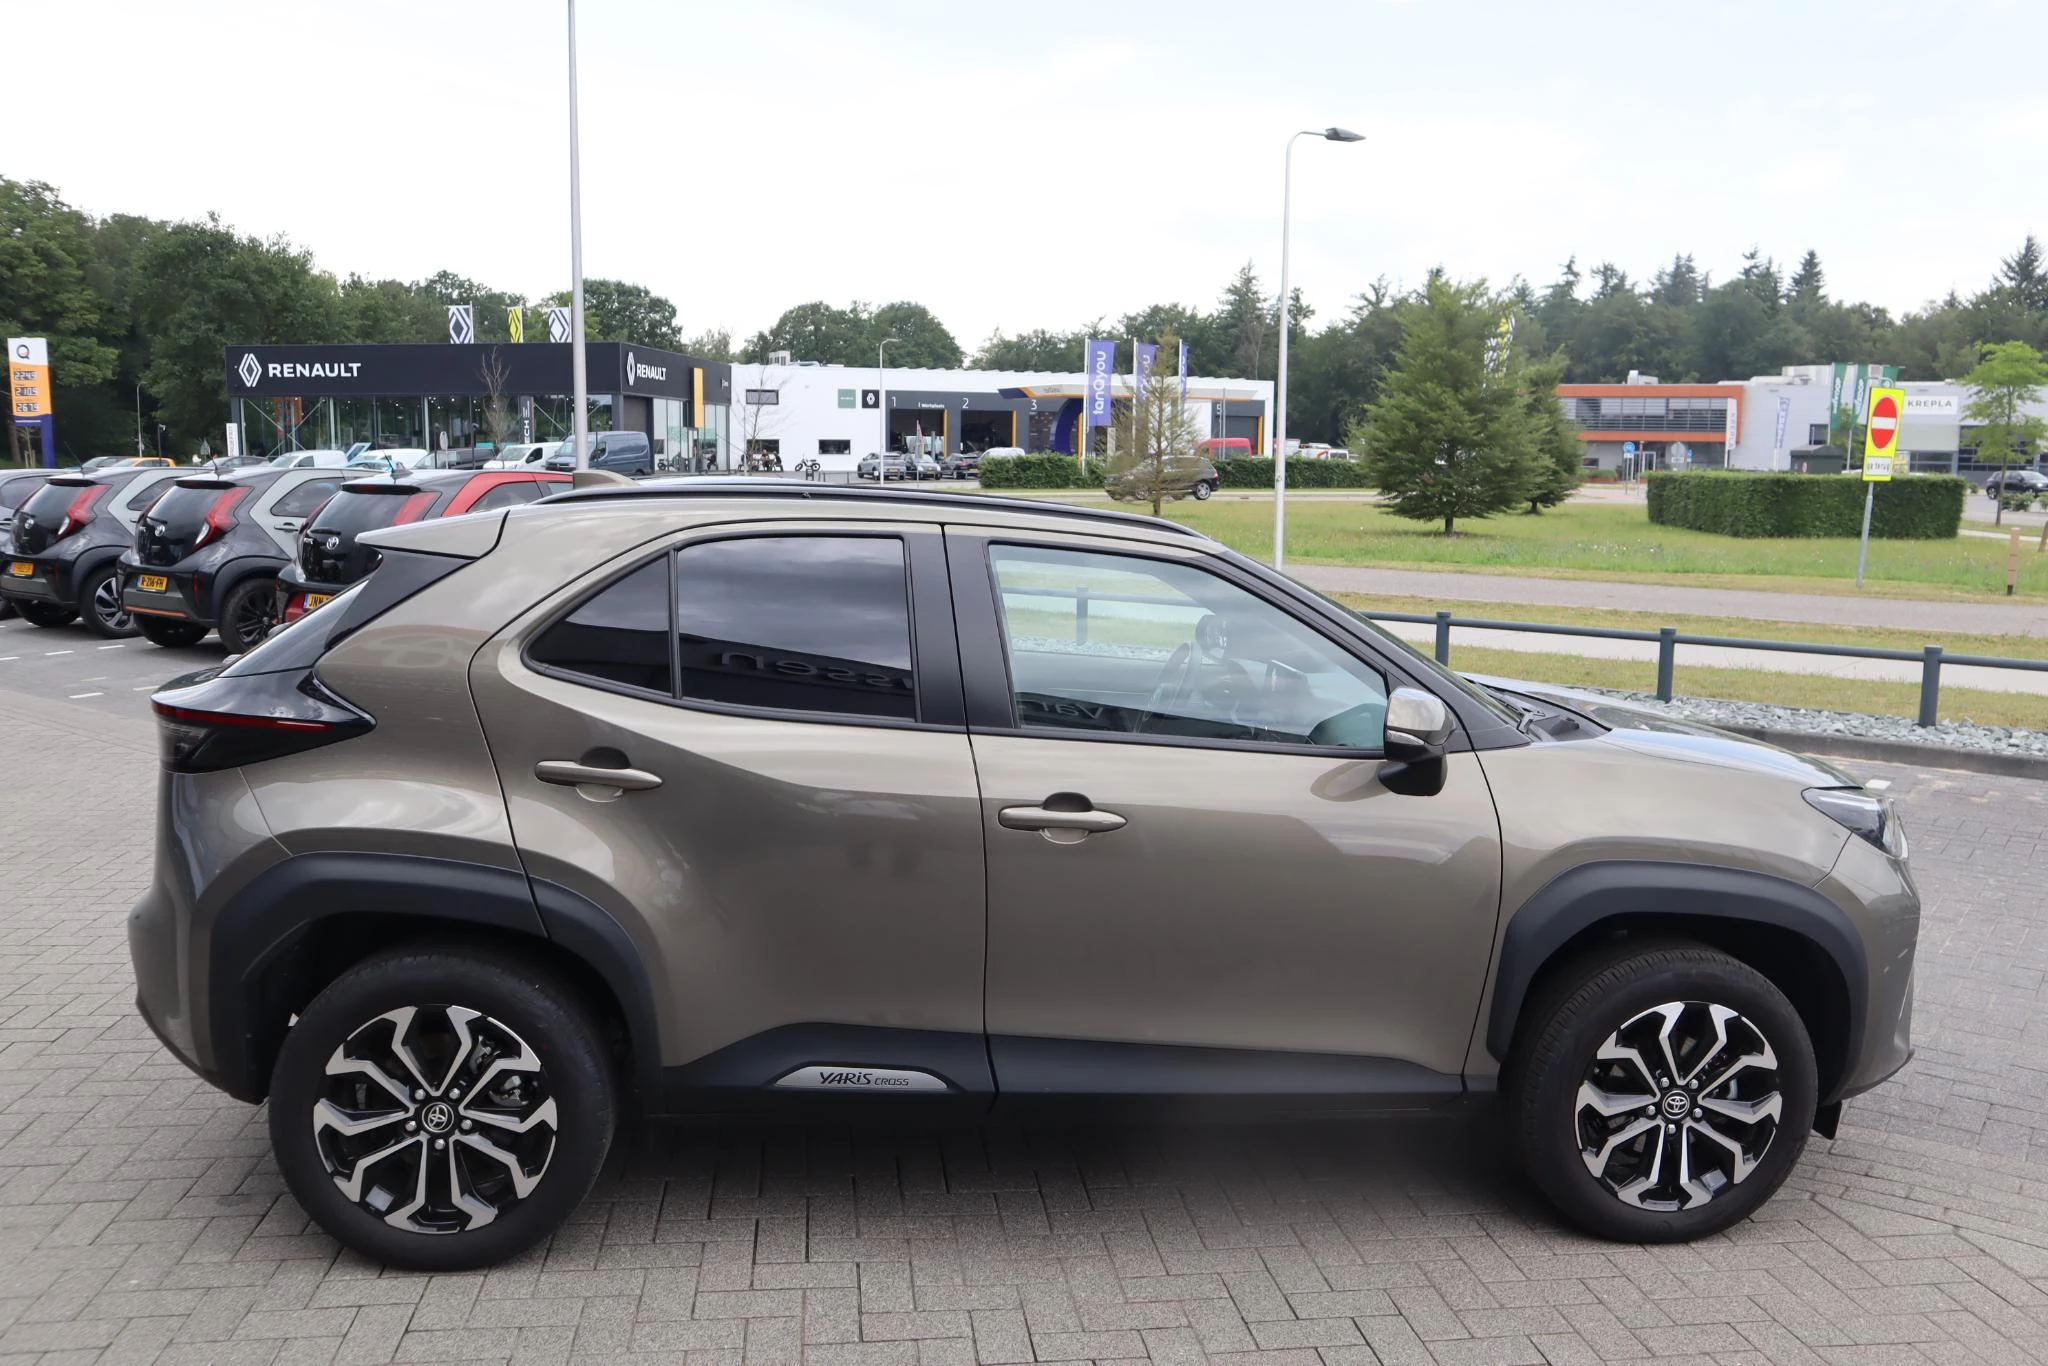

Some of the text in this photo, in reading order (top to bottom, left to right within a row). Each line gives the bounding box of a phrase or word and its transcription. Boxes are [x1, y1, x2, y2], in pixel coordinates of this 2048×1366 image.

[267, 363, 361, 377] RENAULT
[636, 363, 667, 381] RENAULT
[891, 396, 897, 407] 1
[962, 398, 969, 409] 2
[1031, 398, 1038, 410] 3
[1907, 400, 1953, 408] KREPLA
[874, 1077, 909, 1086] CROSS
